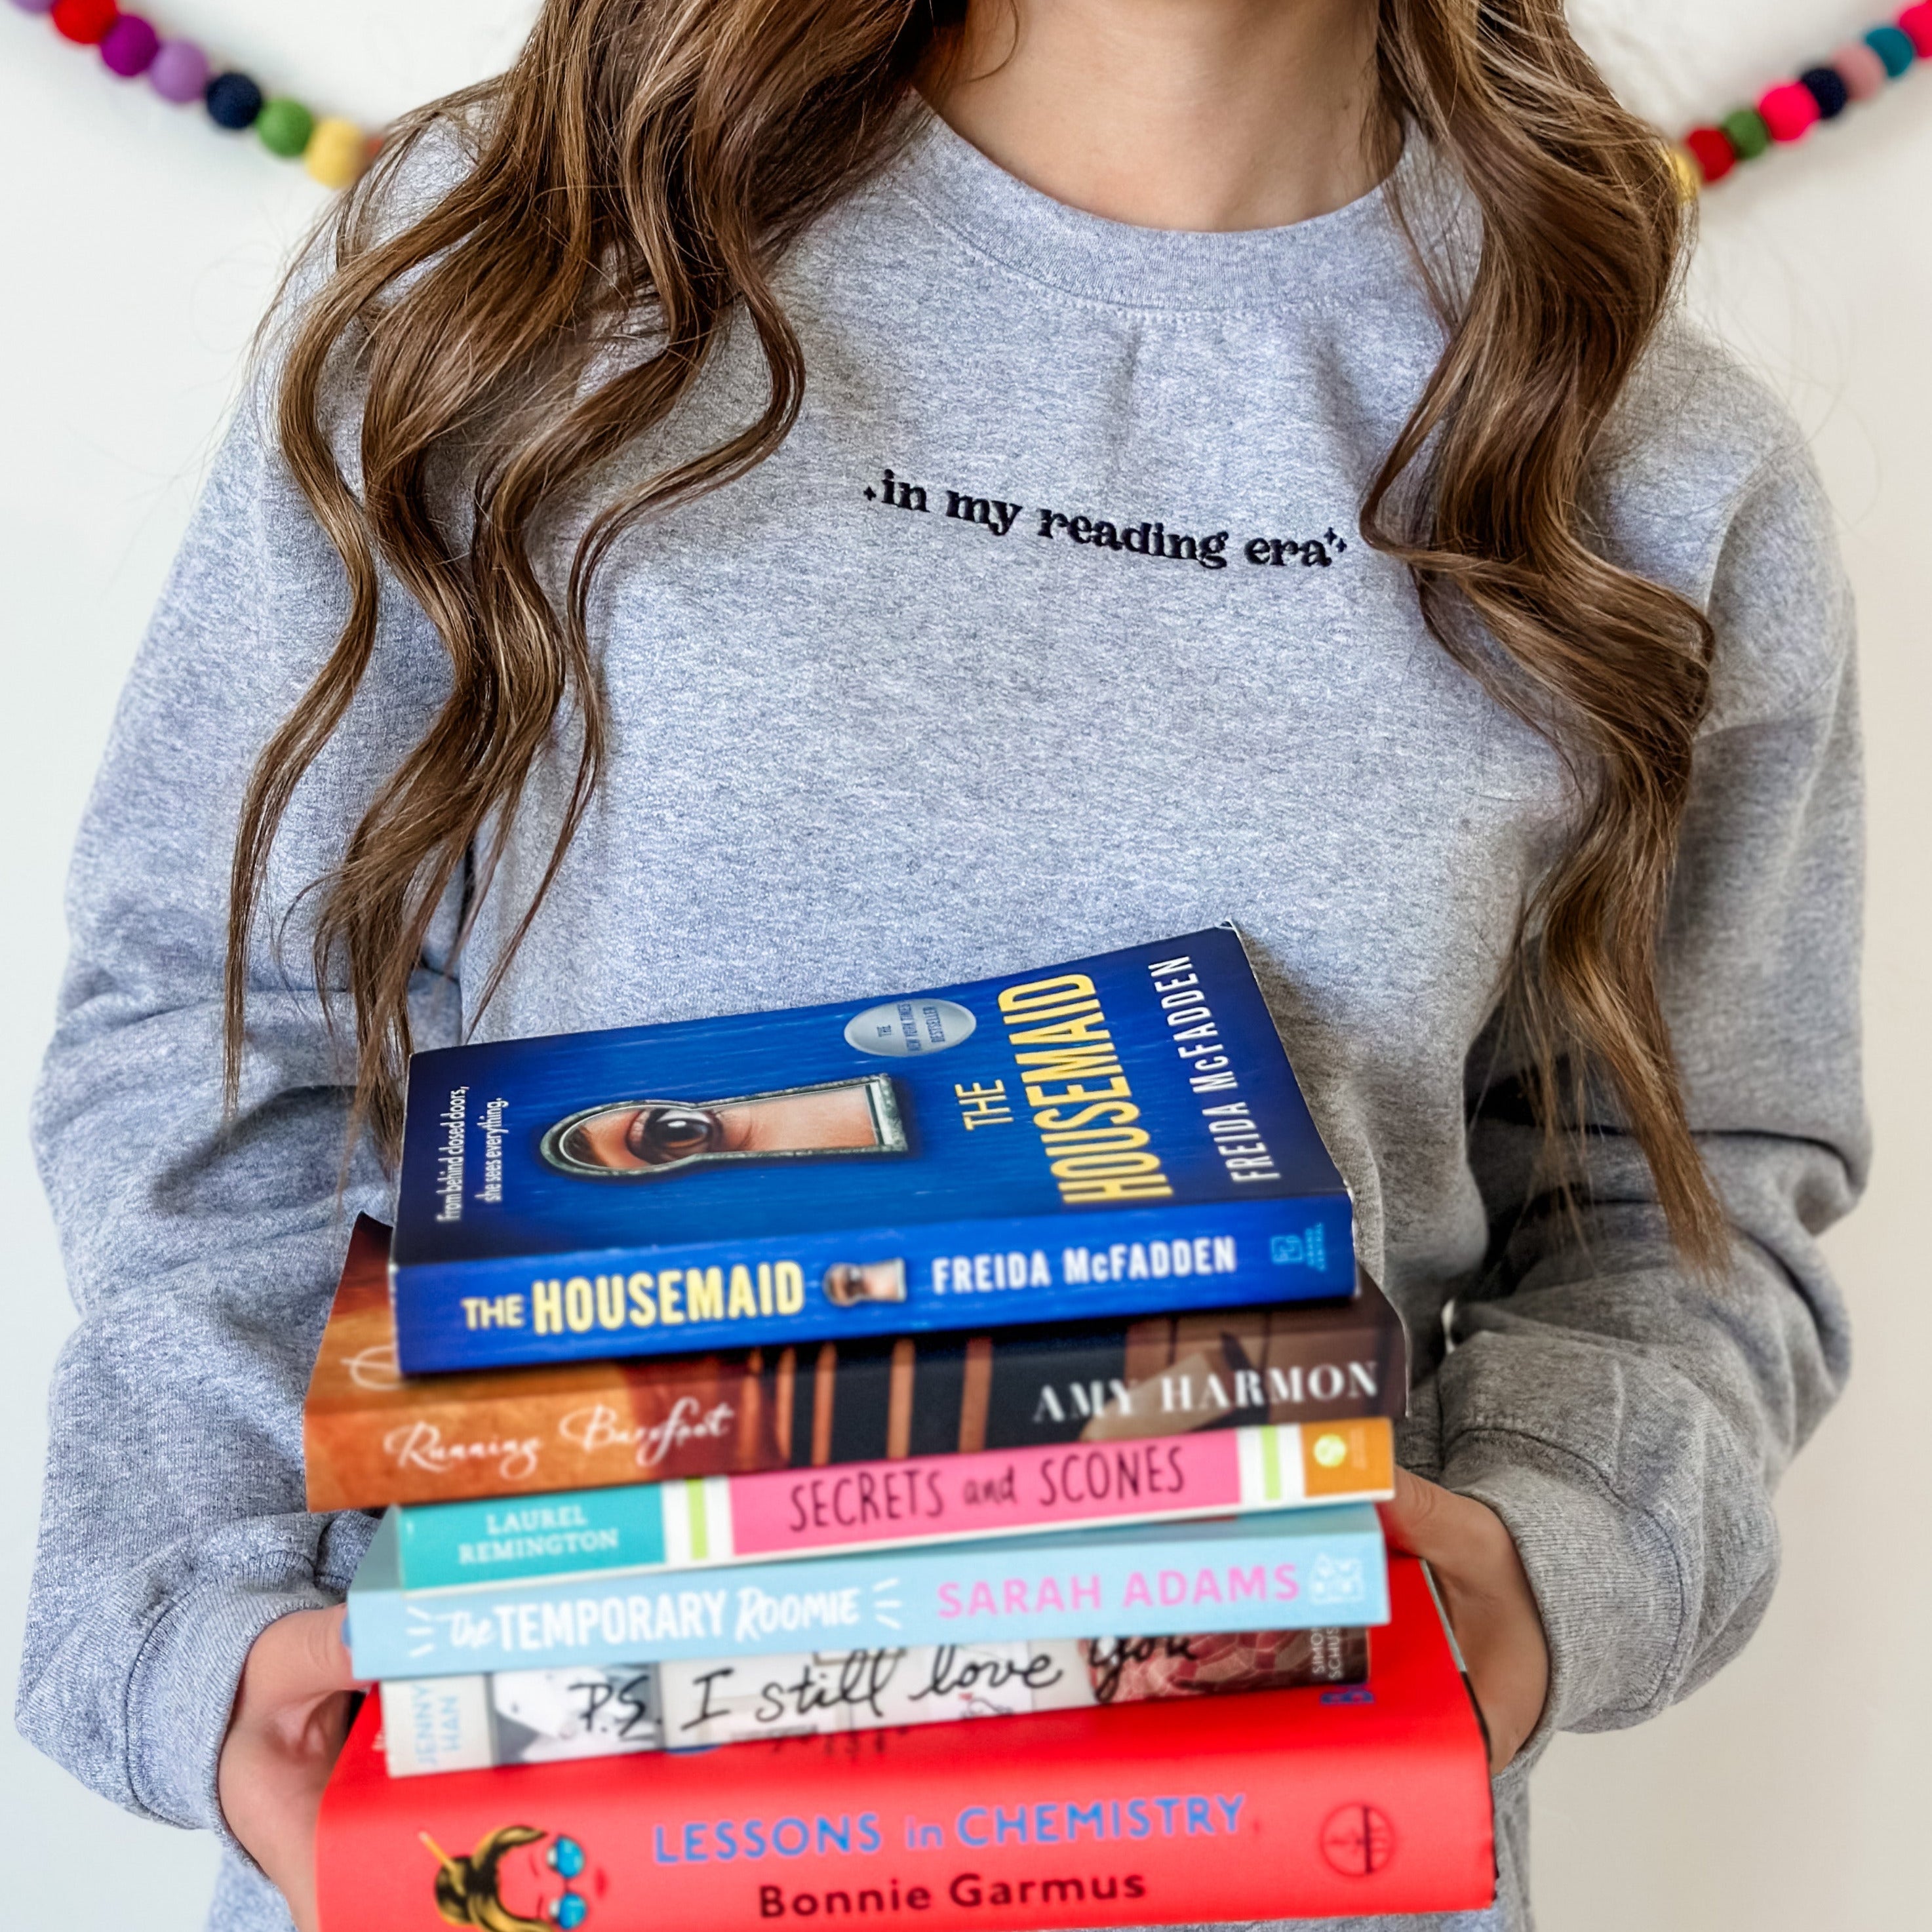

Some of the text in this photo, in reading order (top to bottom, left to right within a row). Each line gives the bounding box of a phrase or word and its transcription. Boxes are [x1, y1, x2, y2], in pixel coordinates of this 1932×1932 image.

[881, 469, 1331, 569] in my reading era
[922, 1006, 945, 1043] BESTSELLER
[955, 1079, 1014, 1131] THE
[997, 974, 1173, 1204] HOUSEMAID
[435, 1086, 469, 1222] from behind closed doors,
[475, 1097, 509, 1203] she sees everything.
[1202, 1101, 1280, 1182] FREIDA
[462, 1261, 804, 1335] THE HOUSEMAID
[932, 1236, 1236, 1295] FREIDA McFADDEN
[1032, 1360, 1379, 1423] AMY HARMON
[383, 1396, 734, 1480] Running Barefoot
[486, 1504, 589, 1536] LAUREL
[789, 1445, 1185, 1532] SECRETS and SCONES
[458, 1528, 619, 1566] REMINGTON
[494, 1590, 728, 1651] TEMPORARY
[937, 1564, 1301, 1619] SARAH ADAMS
[1310, 1627, 1325, 1674] SIMO
[680, 1667, 734, 1731] I
[755, 1648, 903, 1723] still
[908, 1644, 1062, 1701] love
[410, 1682, 438, 1767] JENNY
[439, 1695, 460, 1752] HAN
[654, 1793, 1246, 1864] LESSONS in CHEMISTRY
[758, 1873, 1146, 1919] Bonnie Garmus
